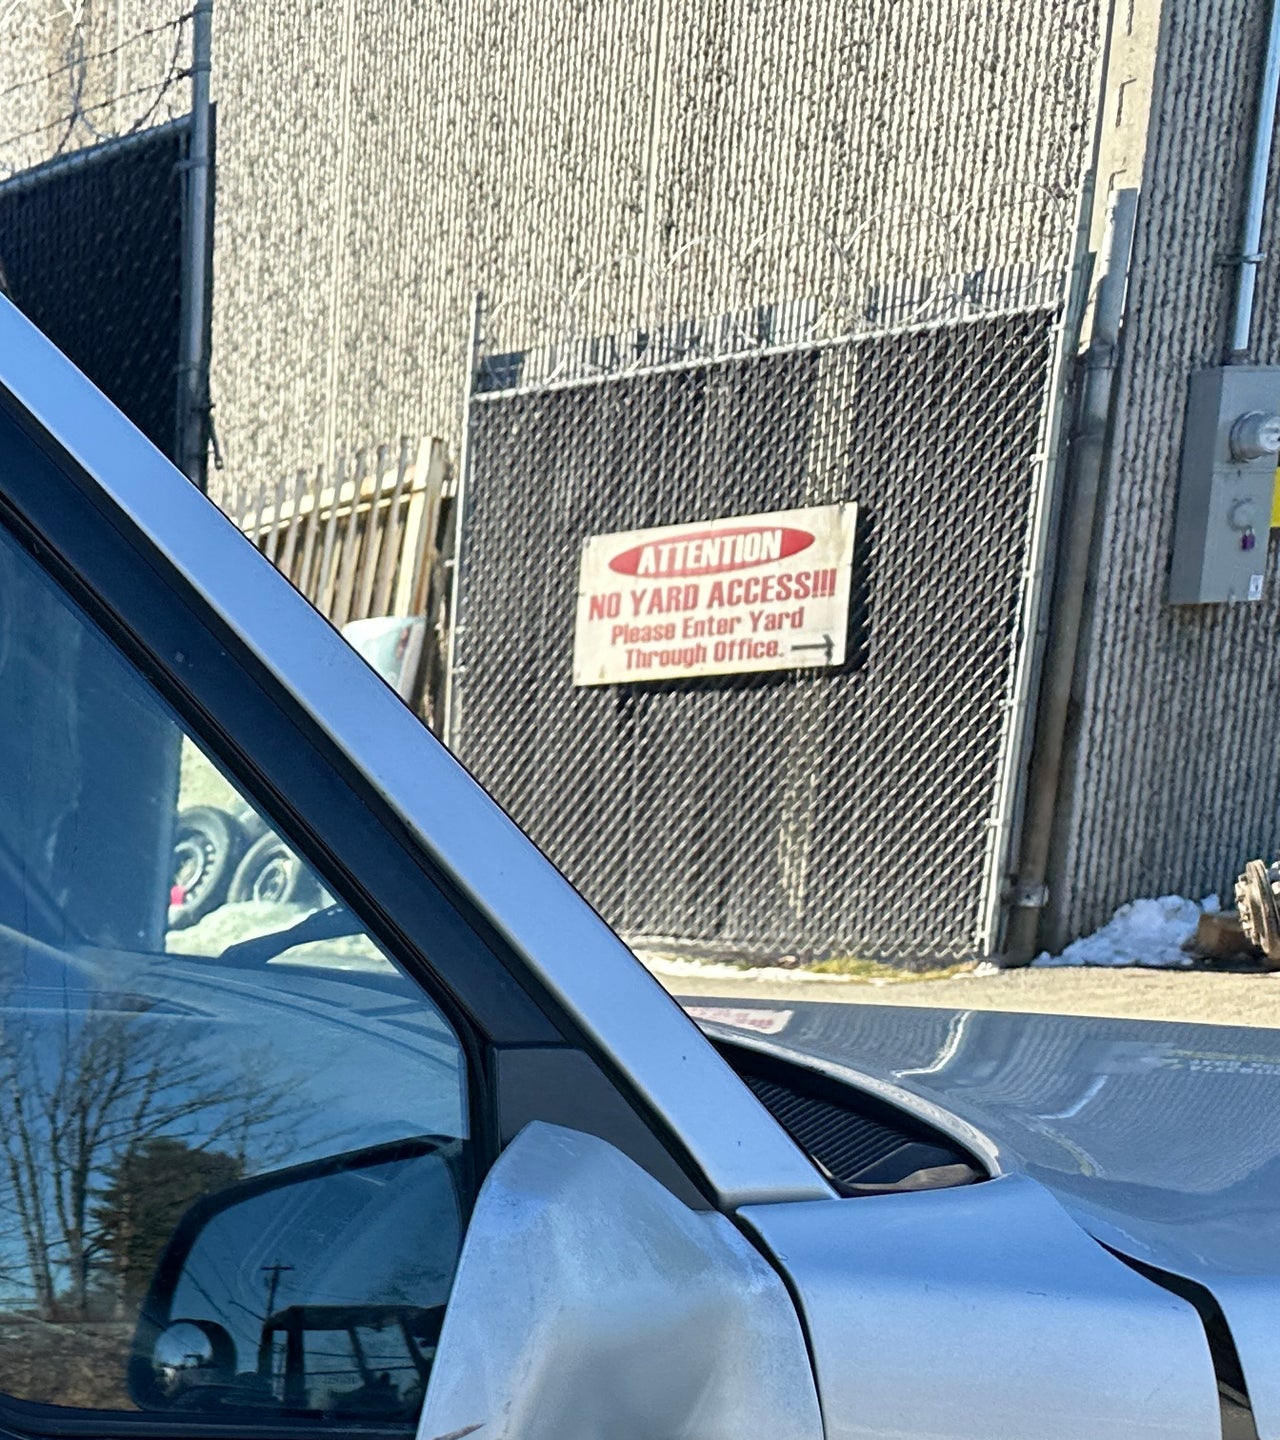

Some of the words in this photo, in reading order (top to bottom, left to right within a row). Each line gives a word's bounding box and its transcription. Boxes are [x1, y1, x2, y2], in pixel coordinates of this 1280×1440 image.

[637, 529, 783, 575] ATTENTION
[589, 592, 620, 621] NO
[630, 583, 700, 617] YARD
[706, 568, 838, 609] ACCESS!!!
[611, 621, 676, 646] Please
[682, 616, 742, 637] Enter
[748, 606, 805, 633] Yard
[625, 643, 708, 671] Through
